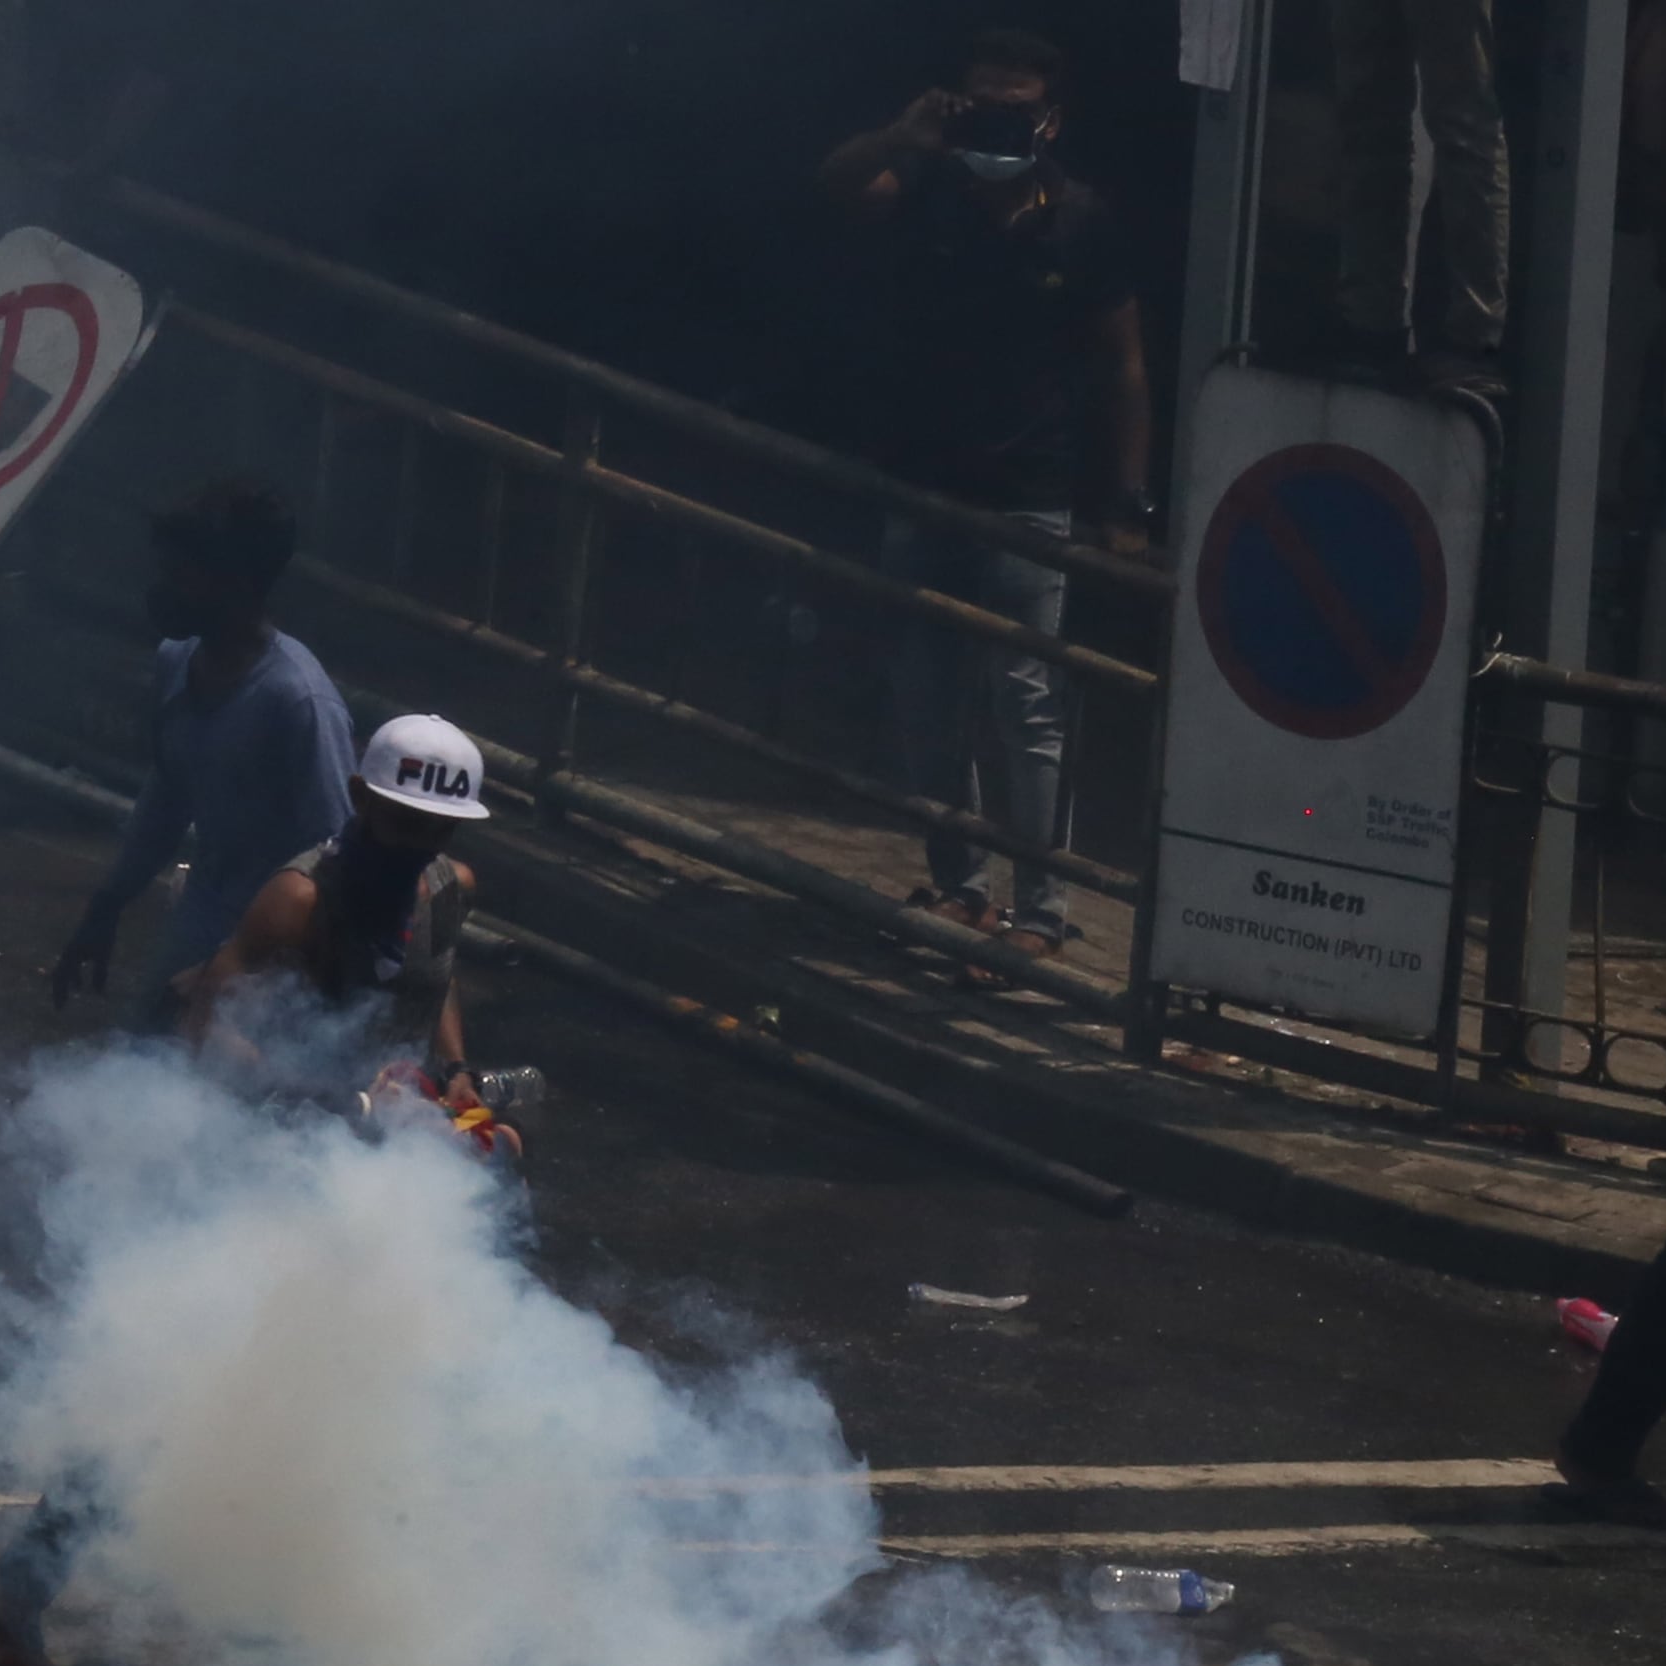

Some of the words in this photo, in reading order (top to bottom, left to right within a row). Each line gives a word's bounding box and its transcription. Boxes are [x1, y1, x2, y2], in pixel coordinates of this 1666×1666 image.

[396, 757, 470, 798] FILA
[1252, 870, 1365, 917] Sanken
[1181, 908, 1329, 954] CONSTRUCTION
[1333, 937, 1383, 968] (PVT)
[1388, 949, 1423, 972] LTD
